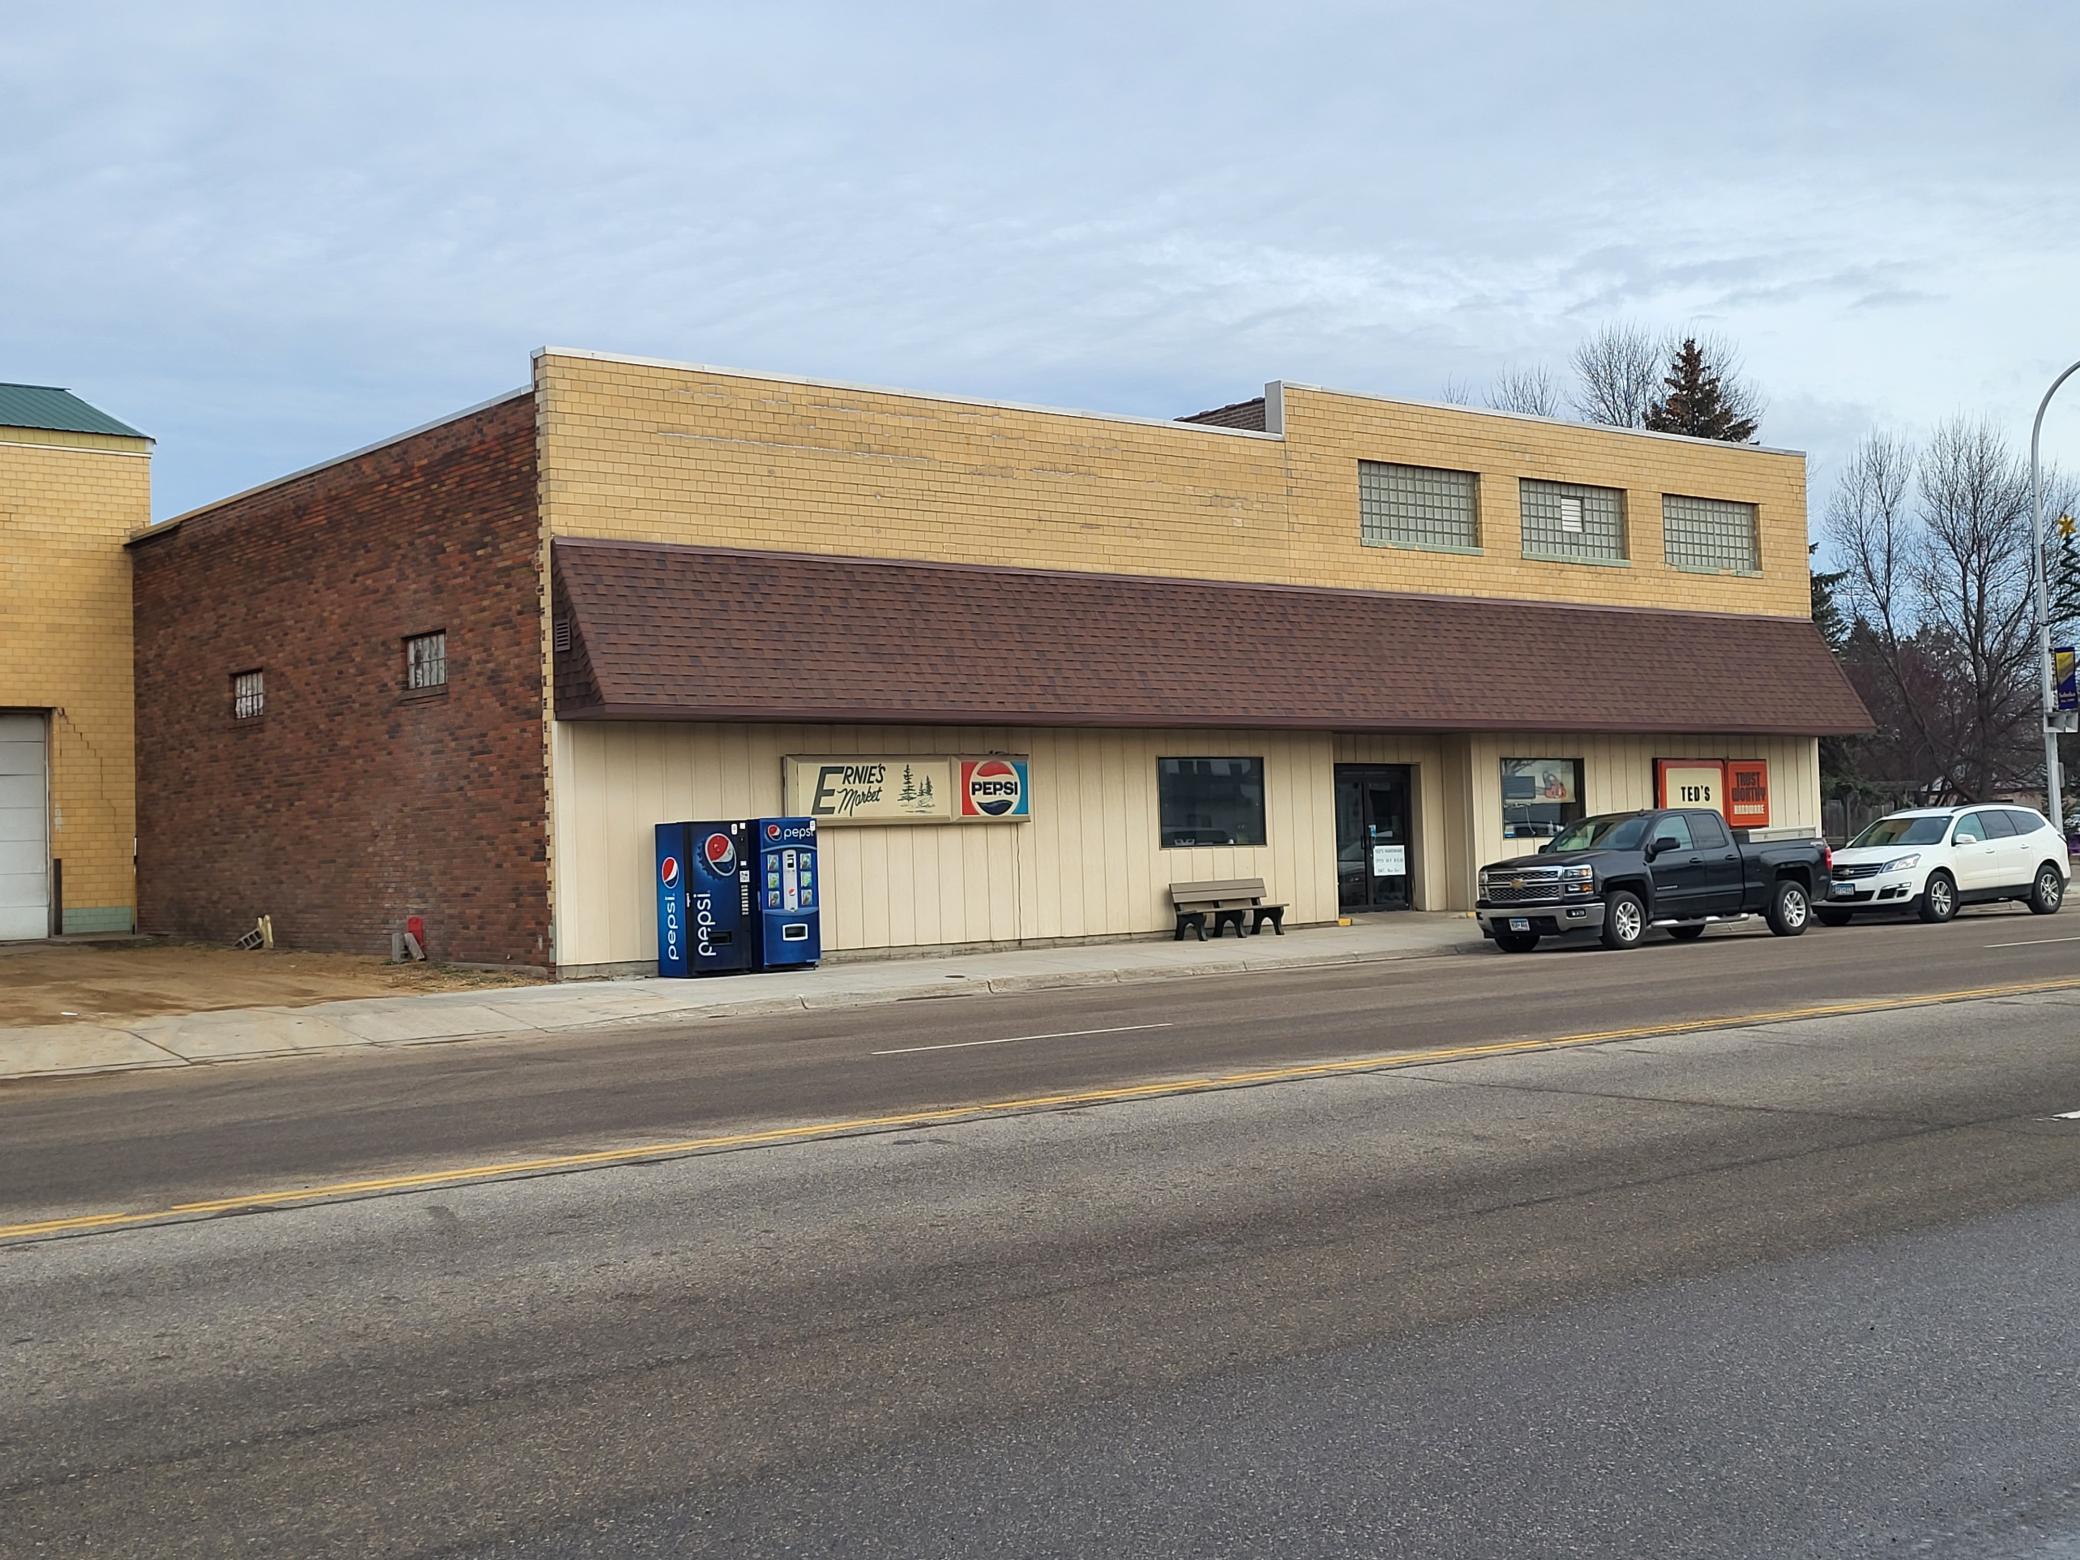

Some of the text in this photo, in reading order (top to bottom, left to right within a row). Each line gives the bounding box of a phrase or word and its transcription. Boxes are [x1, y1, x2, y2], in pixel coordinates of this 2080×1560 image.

[811, 763, 886, 815] ERNIE'S
[837, 786, 883, 817] Market
[971, 781, 1019, 796] PEPSI
[1680, 785, 1711, 802] TED'S
[665, 896, 679, 960] pepsi
[693, 893, 717, 957] pepsi
